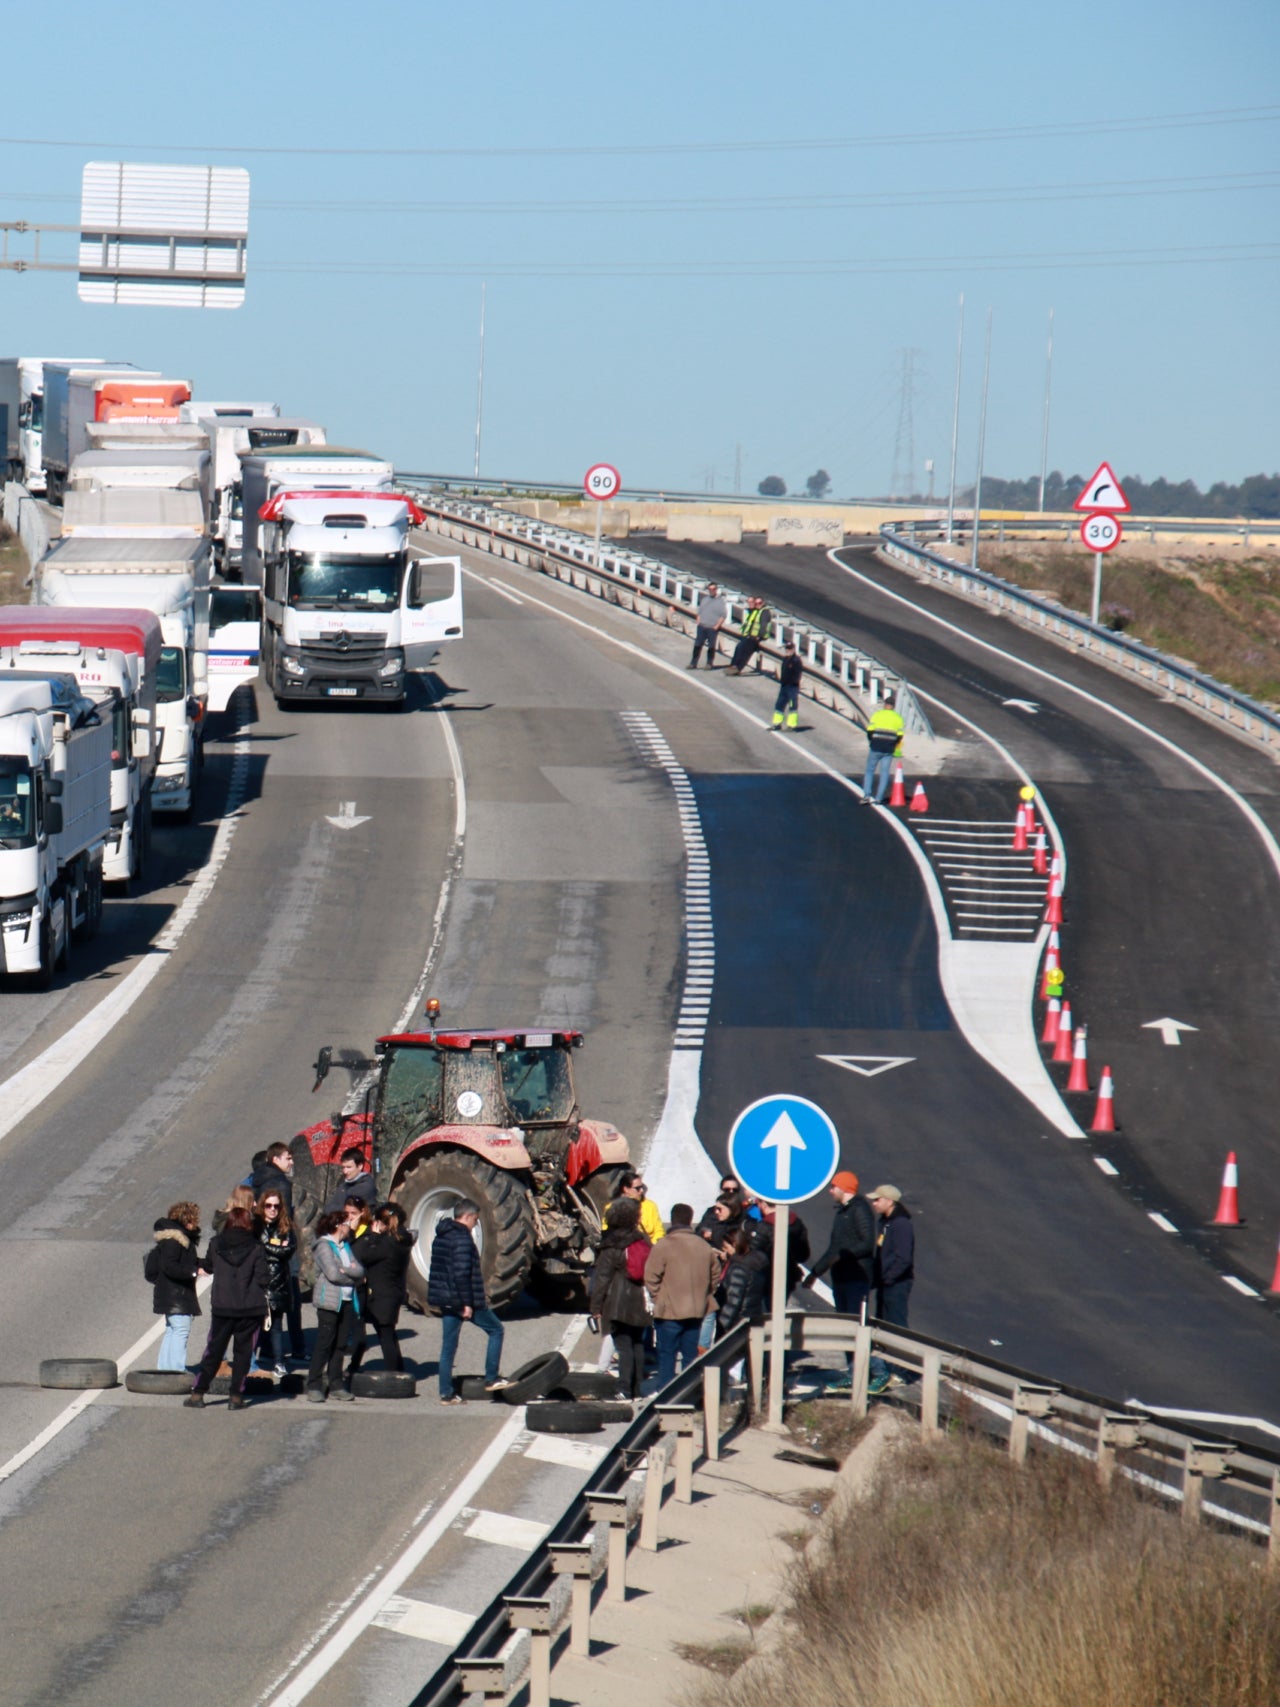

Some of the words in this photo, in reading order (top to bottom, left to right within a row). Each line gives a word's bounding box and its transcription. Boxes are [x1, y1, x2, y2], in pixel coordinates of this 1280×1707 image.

[592, 475, 612, 488] 90
[1089, 525, 1113, 539] 30
[208, 658, 245, 666] ontserrat
